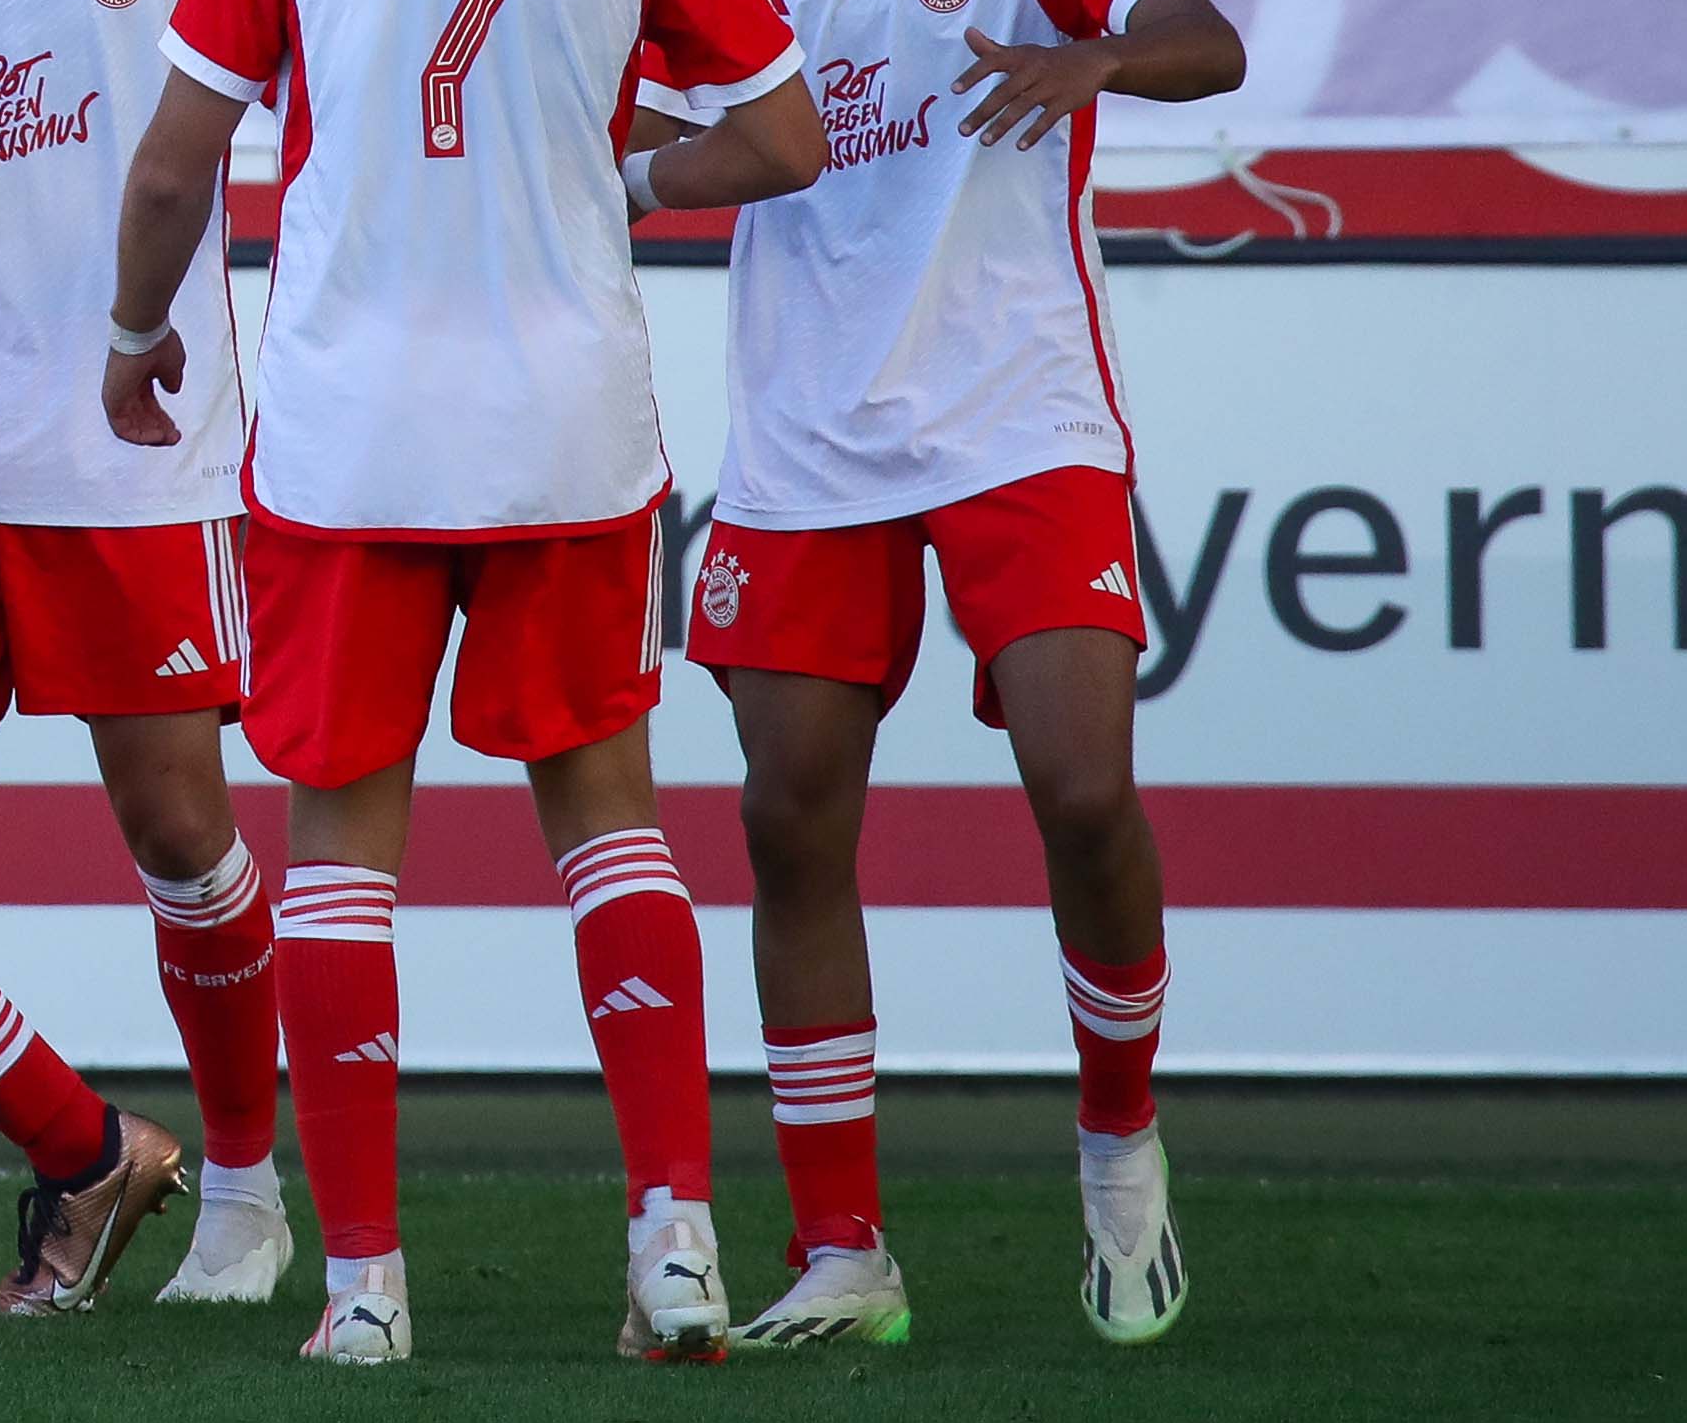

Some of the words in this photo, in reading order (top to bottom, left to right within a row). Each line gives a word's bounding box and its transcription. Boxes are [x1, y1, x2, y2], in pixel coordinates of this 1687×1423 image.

[816, 57, 890, 108] ROT
[821, 82, 885, 135] GEGEN
[824, 94, 939, 174] ASSISMUS
